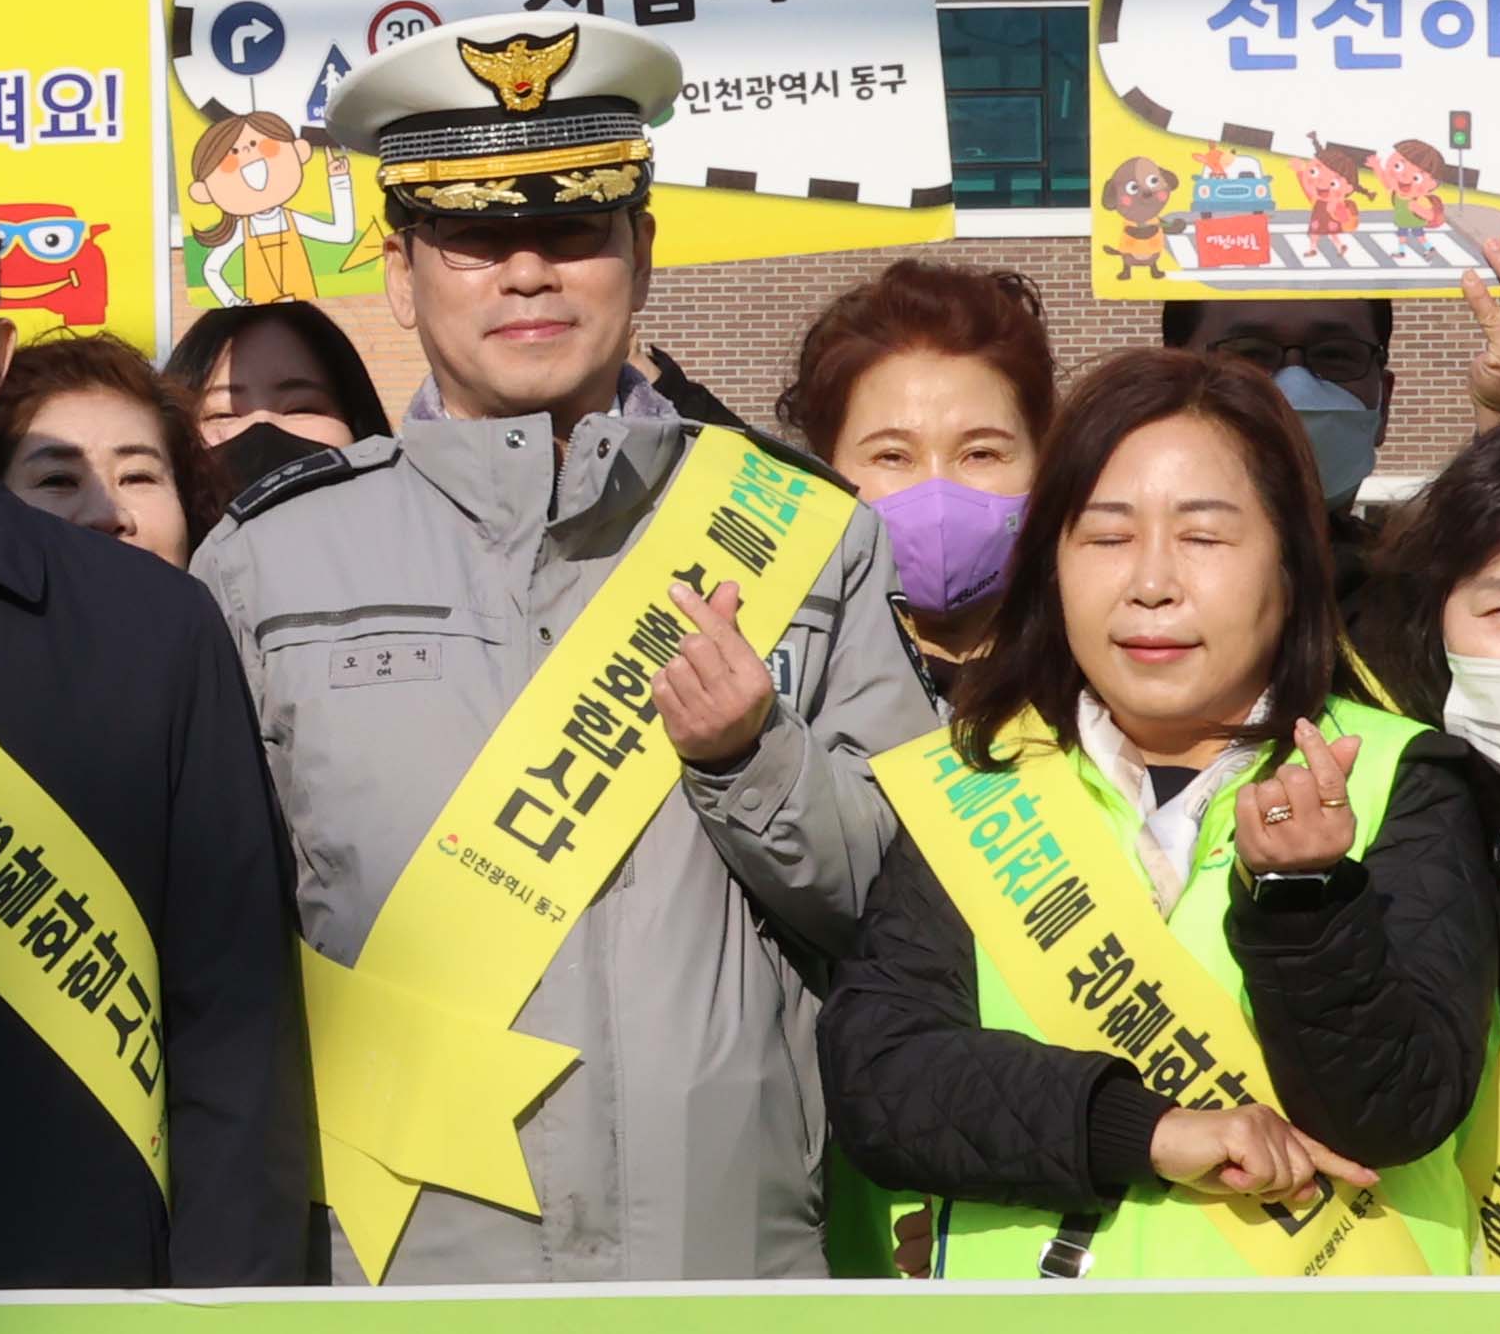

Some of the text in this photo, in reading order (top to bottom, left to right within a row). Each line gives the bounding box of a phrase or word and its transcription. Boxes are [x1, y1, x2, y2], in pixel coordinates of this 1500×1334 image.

[682, 62, 908, 115] 인천광역시 동구
[461, 847, 567, 924] 인천광역시 동구
